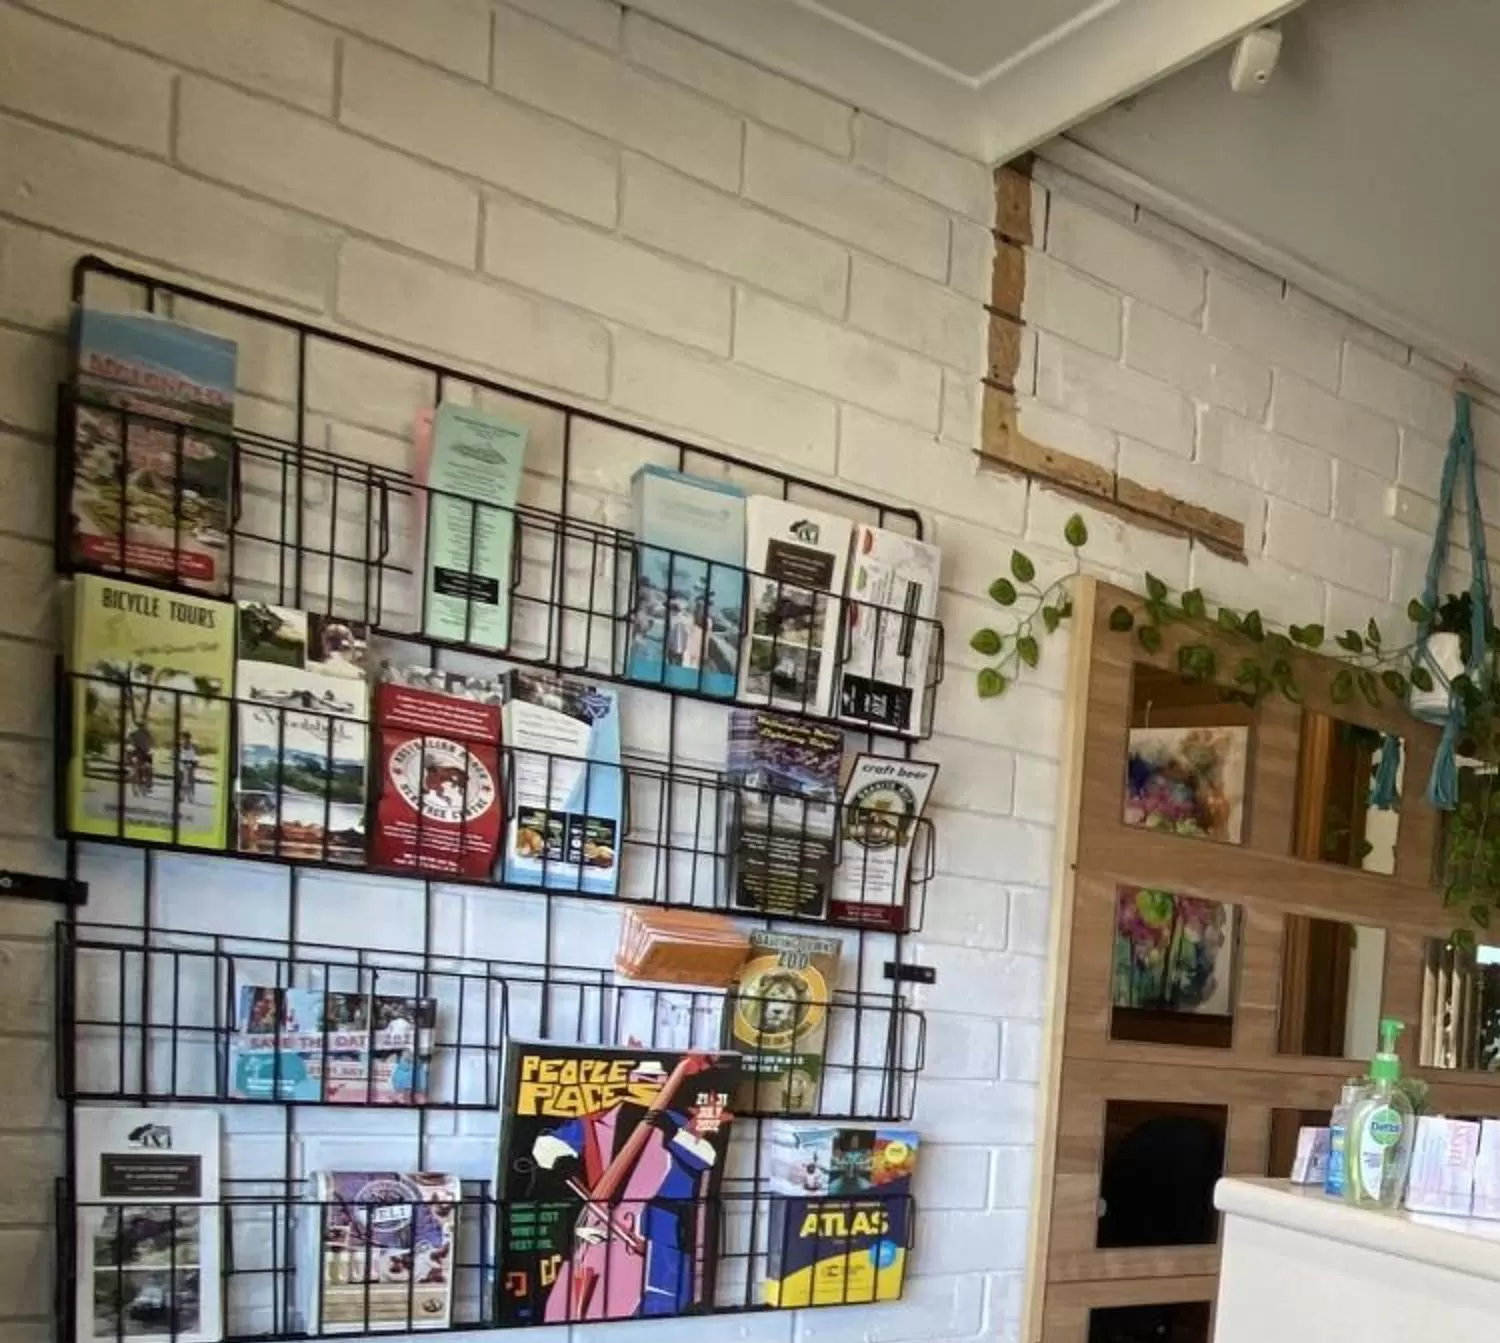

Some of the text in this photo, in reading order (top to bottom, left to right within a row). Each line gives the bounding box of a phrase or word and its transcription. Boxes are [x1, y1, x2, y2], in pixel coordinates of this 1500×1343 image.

[102, 587, 216, 629] BICYCLE TOURS
[862, 764, 928, 779] craft beer
[777, 950, 810, 970] ZOO
[335, 1036, 374, 1048] DAT
[521, 1056, 636, 1085] PEOPLE
[517, 1079, 664, 1118] PLACES
[799, 1211, 889, 1238] ATLAS
